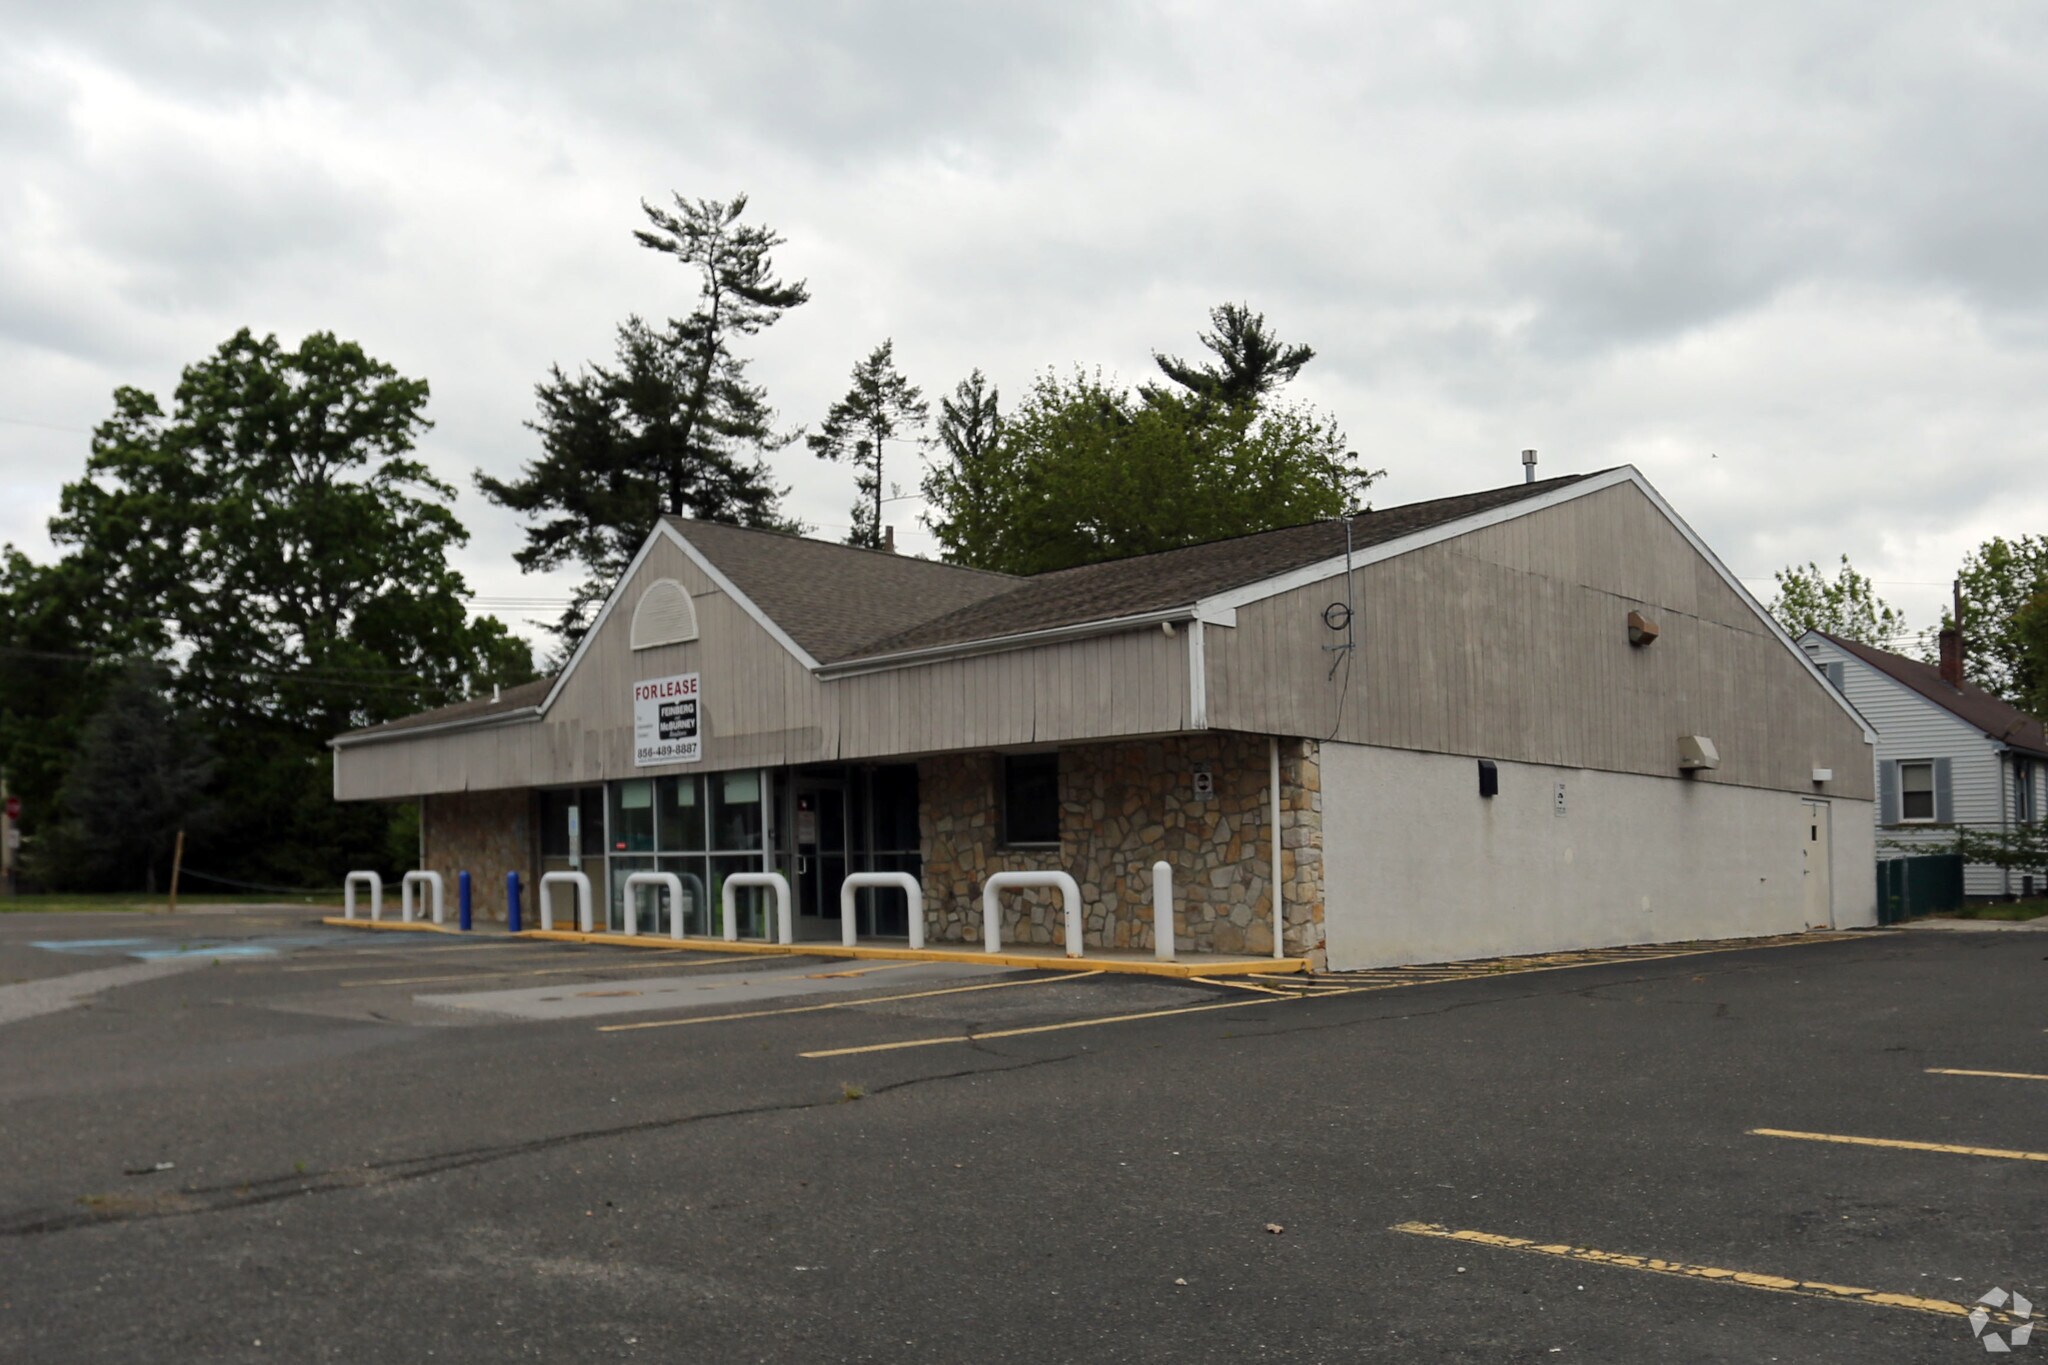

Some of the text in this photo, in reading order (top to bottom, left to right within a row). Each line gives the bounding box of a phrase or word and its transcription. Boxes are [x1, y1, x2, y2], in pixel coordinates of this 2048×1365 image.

[636, 678, 697, 701] FOR LEASE
[637, 743, 697, 759] 856-489-8887
